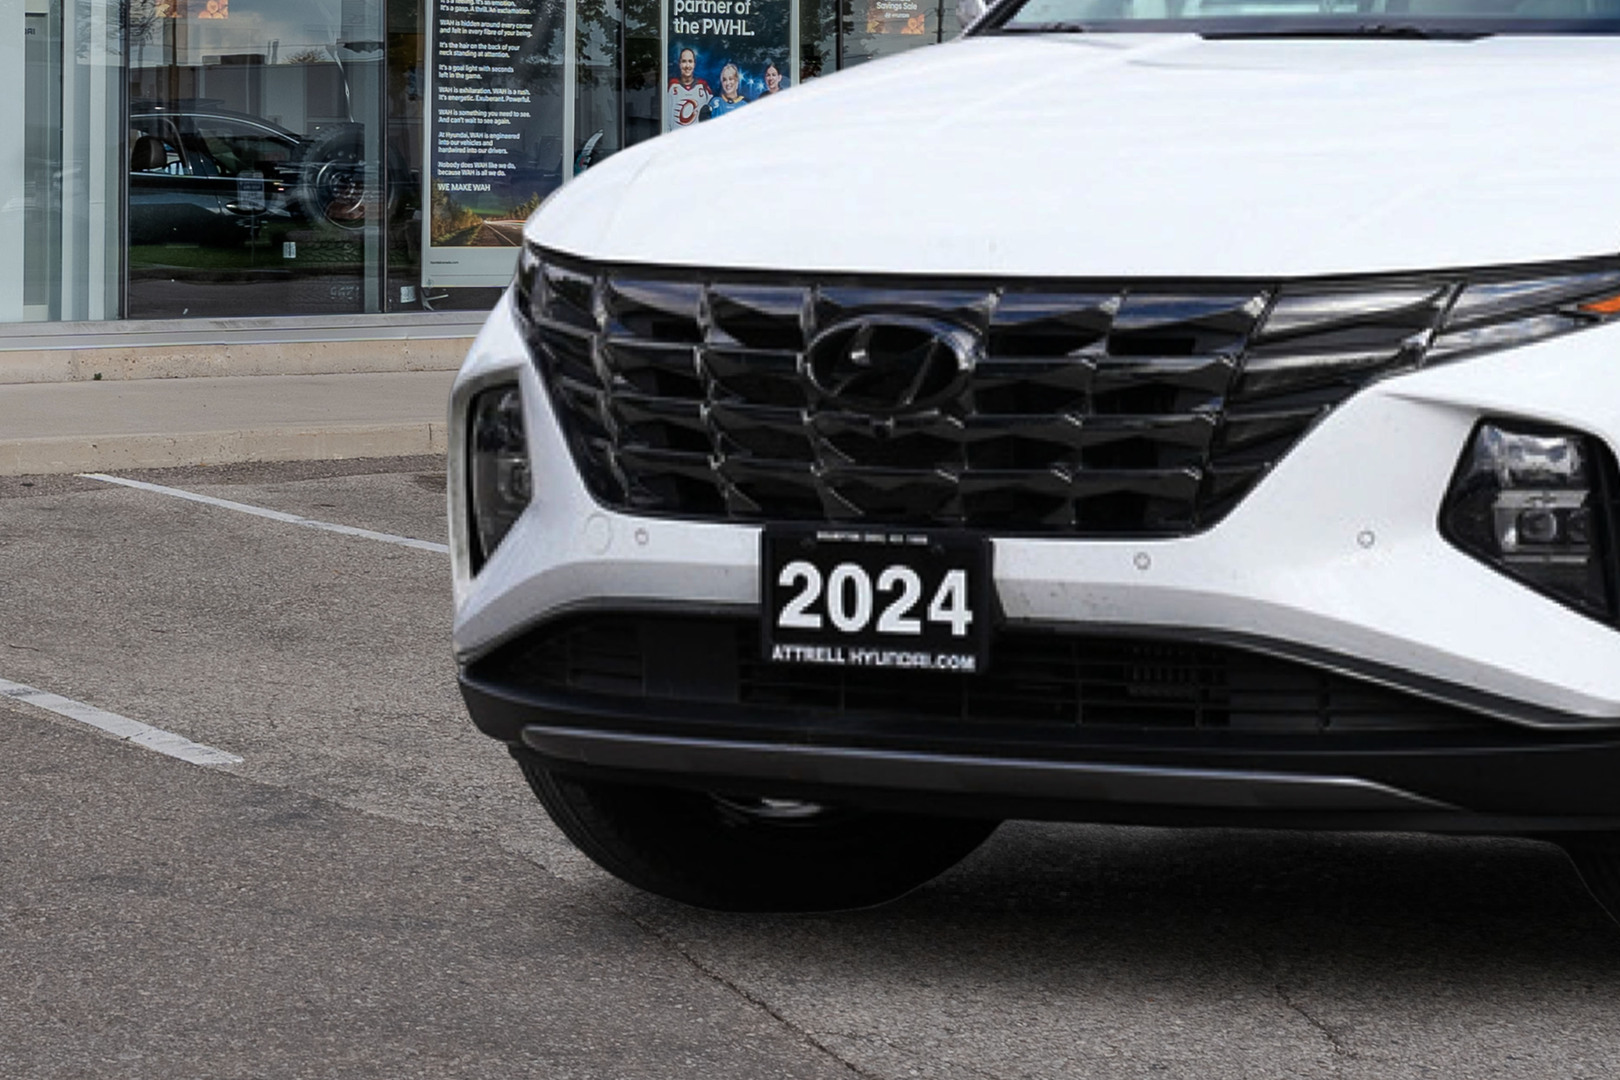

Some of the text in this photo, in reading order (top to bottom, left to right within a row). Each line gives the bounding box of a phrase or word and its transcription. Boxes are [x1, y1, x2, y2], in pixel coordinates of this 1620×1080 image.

[673, 0, 732, 15] partner
[876, 2, 917, 11] Savings Sale
[673, 17, 755, 36] the PWHL.
[438, 183, 450, 191] WE
[451, 183, 472, 191] MAKE
[778, 560, 973, 636] 2024
[772, 644, 845, 663] ATTRELL
